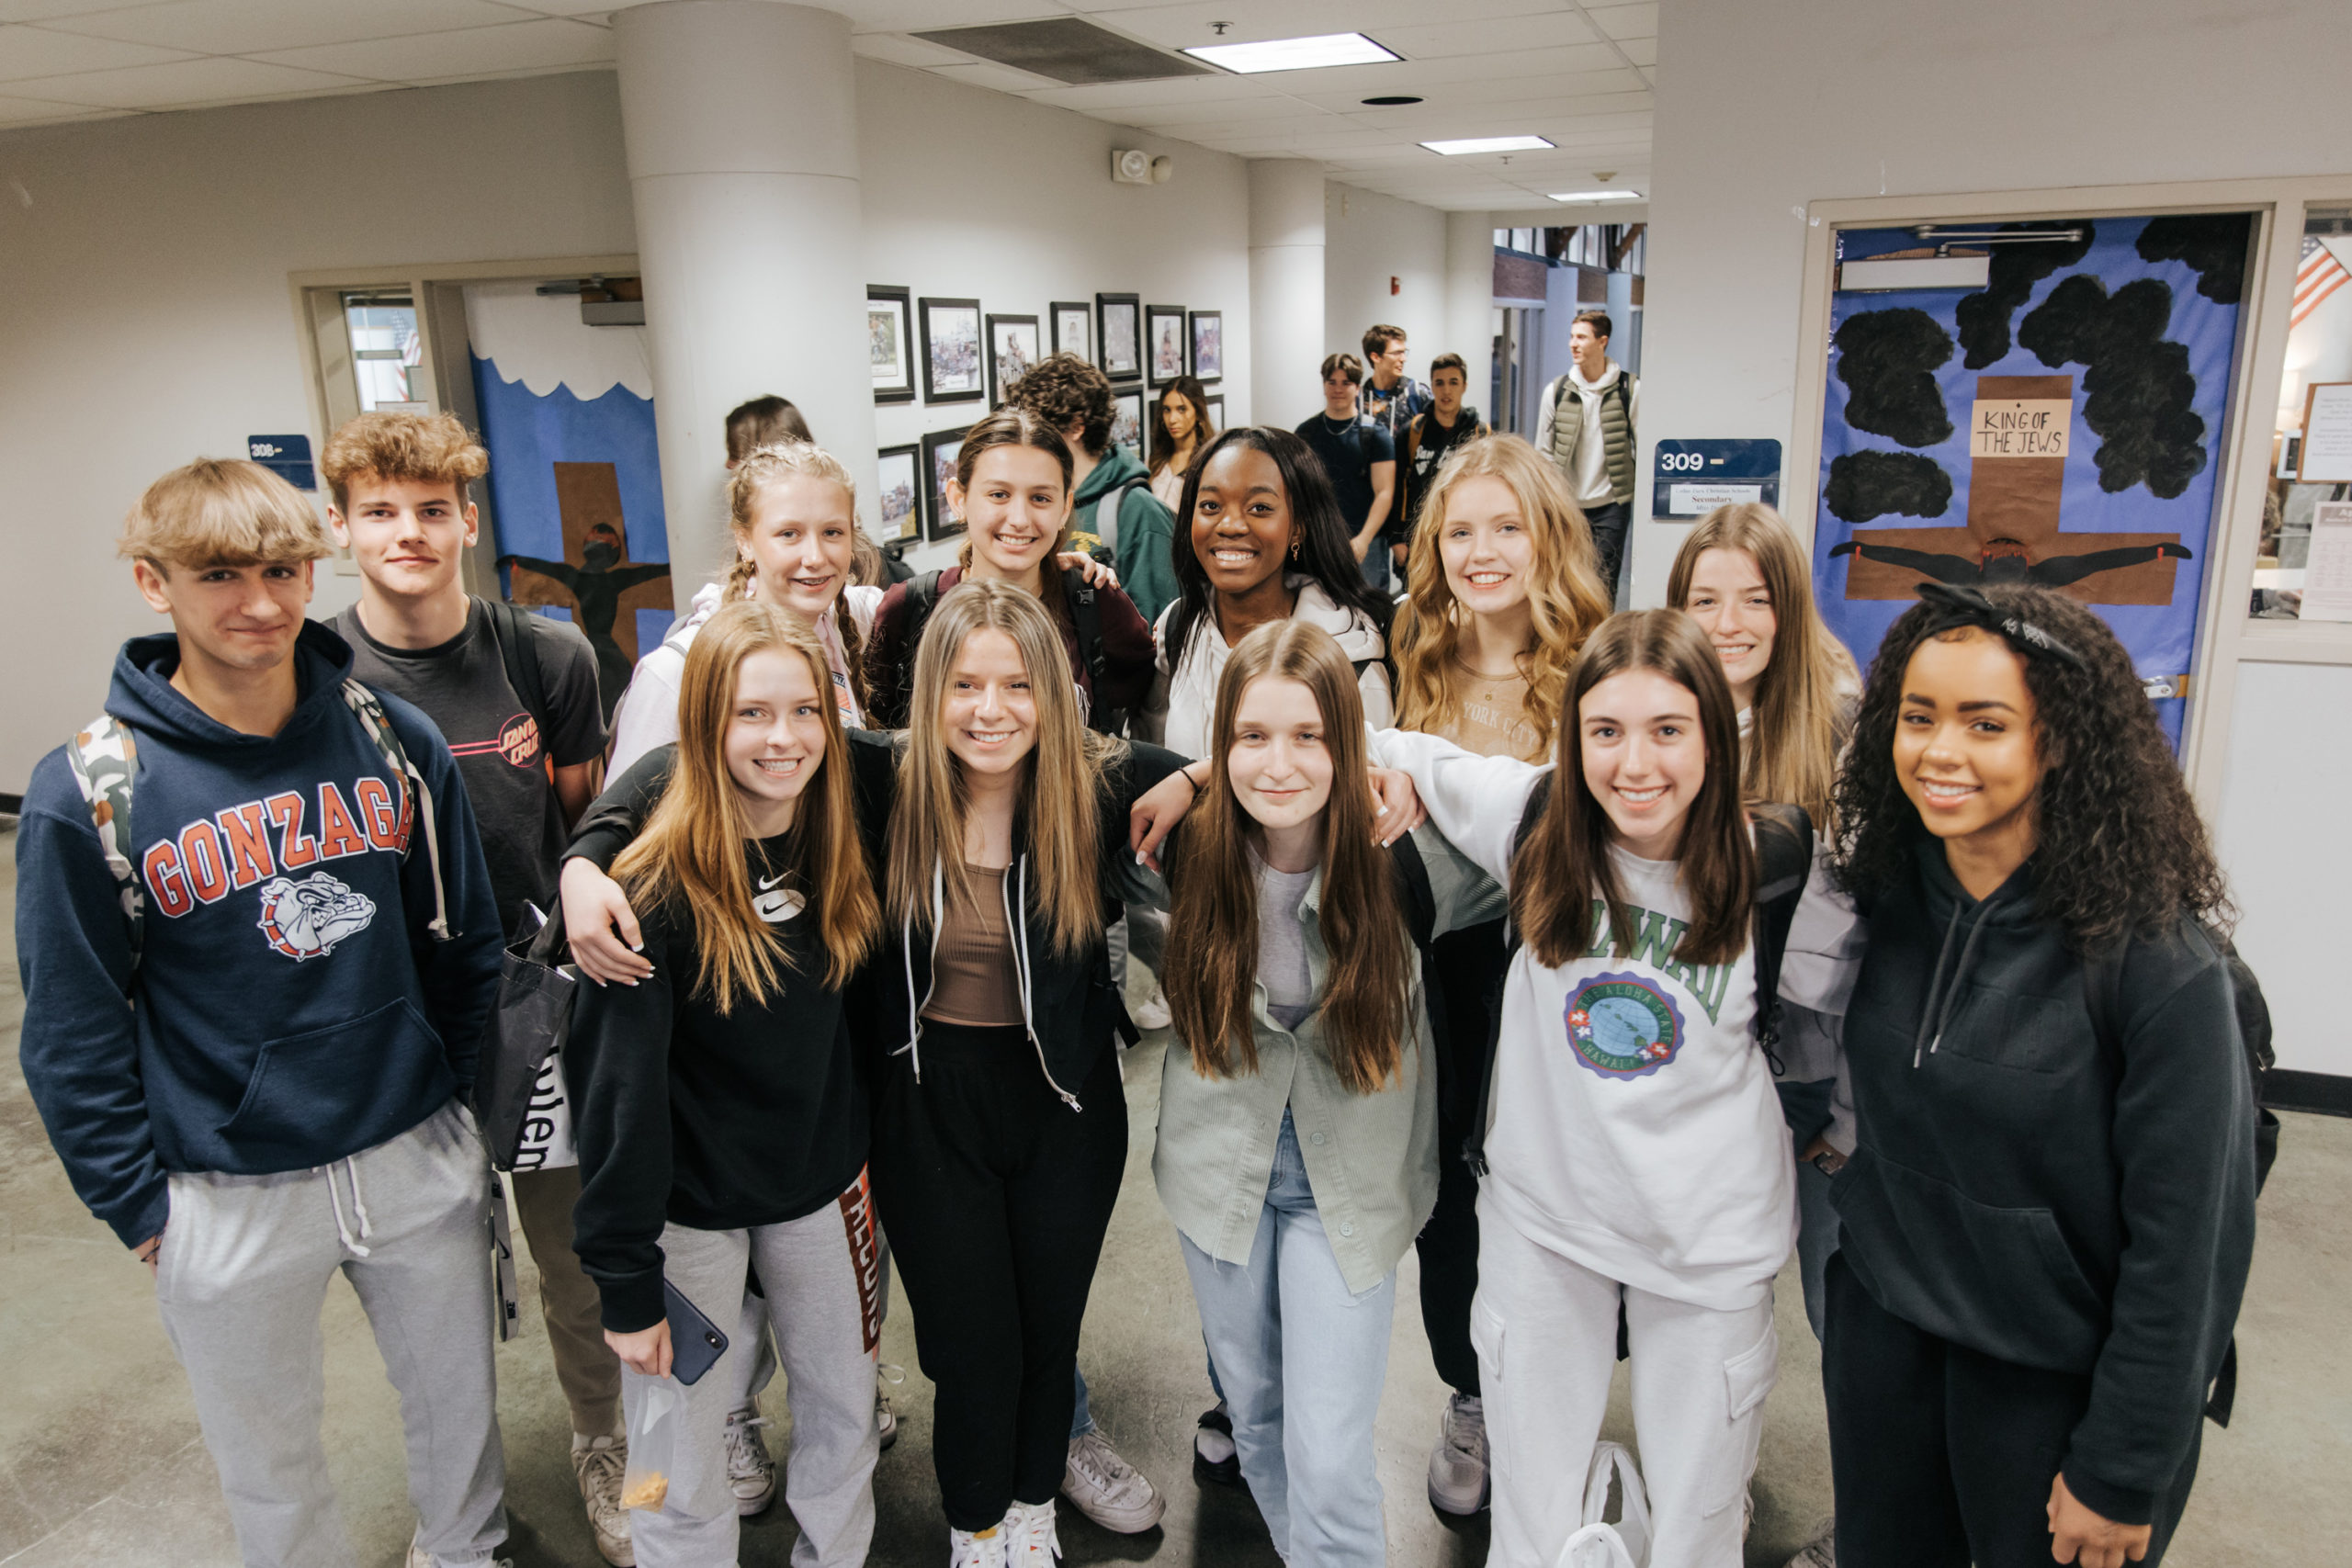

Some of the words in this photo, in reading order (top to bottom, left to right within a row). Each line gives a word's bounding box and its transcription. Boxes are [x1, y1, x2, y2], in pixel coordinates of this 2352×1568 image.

[1984, 412, 2029, 430] KING
[2032, 412, 2051, 430] OF
[1976, 431, 2013, 453] THE
[2018, 431, 2063, 454] JEWS
[1661, 453, 1703, 471] 309
[1463, 702, 1499, 728] YORK
[1502, 717, 1537, 747] CITY
[143, 777, 413, 919] GONZAGA
[1578, 987, 1600, 1009] THE
[1605, 986, 1652, 1003] ALOHA
[1654, 1003, 1672, 1042] STATE
